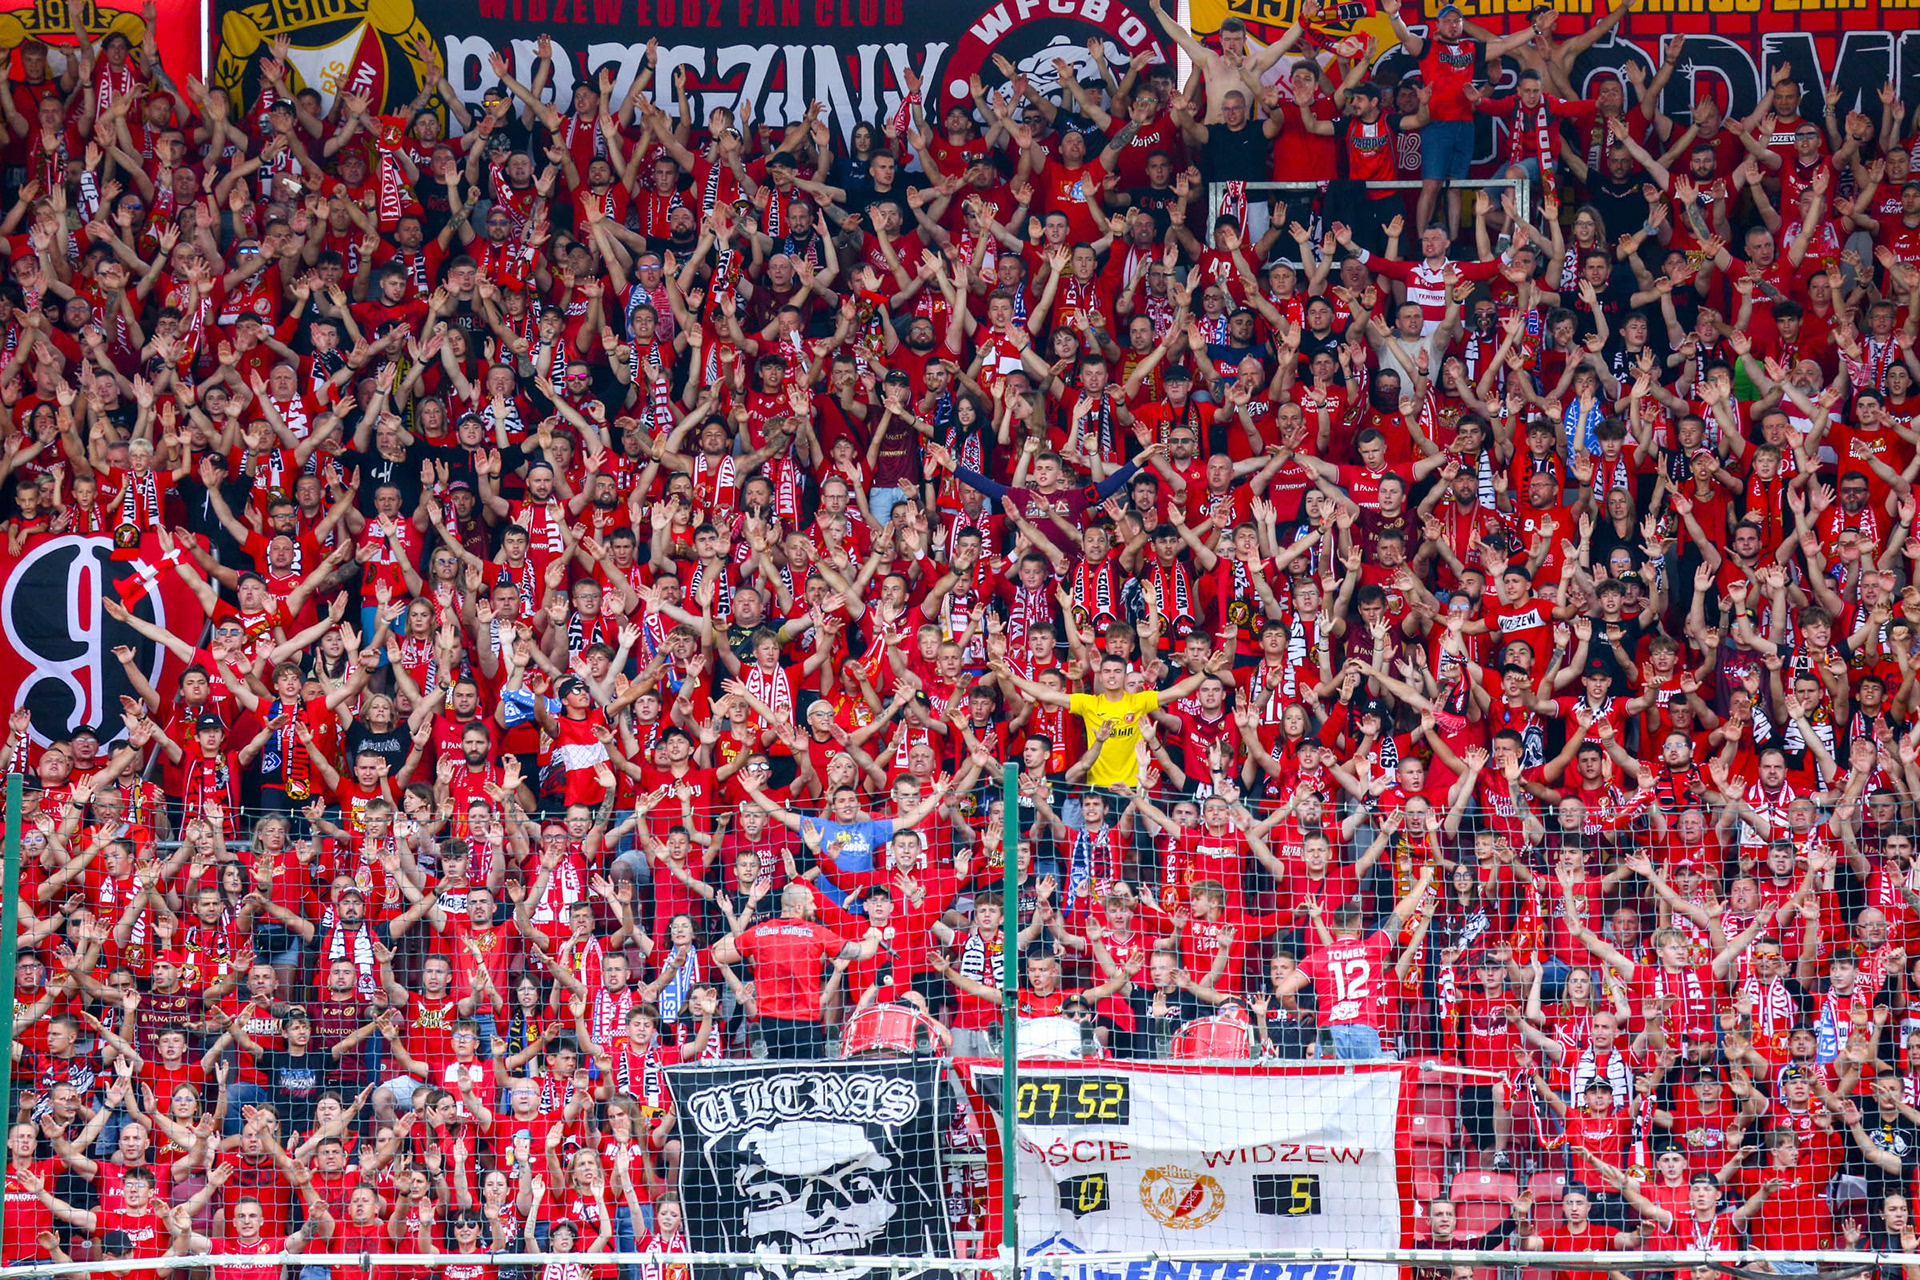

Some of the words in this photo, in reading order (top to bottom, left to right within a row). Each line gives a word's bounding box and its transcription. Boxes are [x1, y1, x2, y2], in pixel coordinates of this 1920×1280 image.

[740, 0, 801, 26] FAN
[814, 0, 904, 26] CLUB
[1131, 130, 1160, 147] hojny
[1326, 947, 1368, 960] TOMEK
[1327, 959, 1371, 1001] 12
[148, 1013, 191, 1023] PANATTONI
[689, 1071, 920, 1136] ULTRAS
[1017, 1083, 1061, 1118] 07
[1074, 1083, 1124, 1118] 52
[1201, 1143, 1365, 1169] WIDZEW
[1078, 1176, 1104, 1212] 0
[1287, 1177, 1312, 1214] 5
